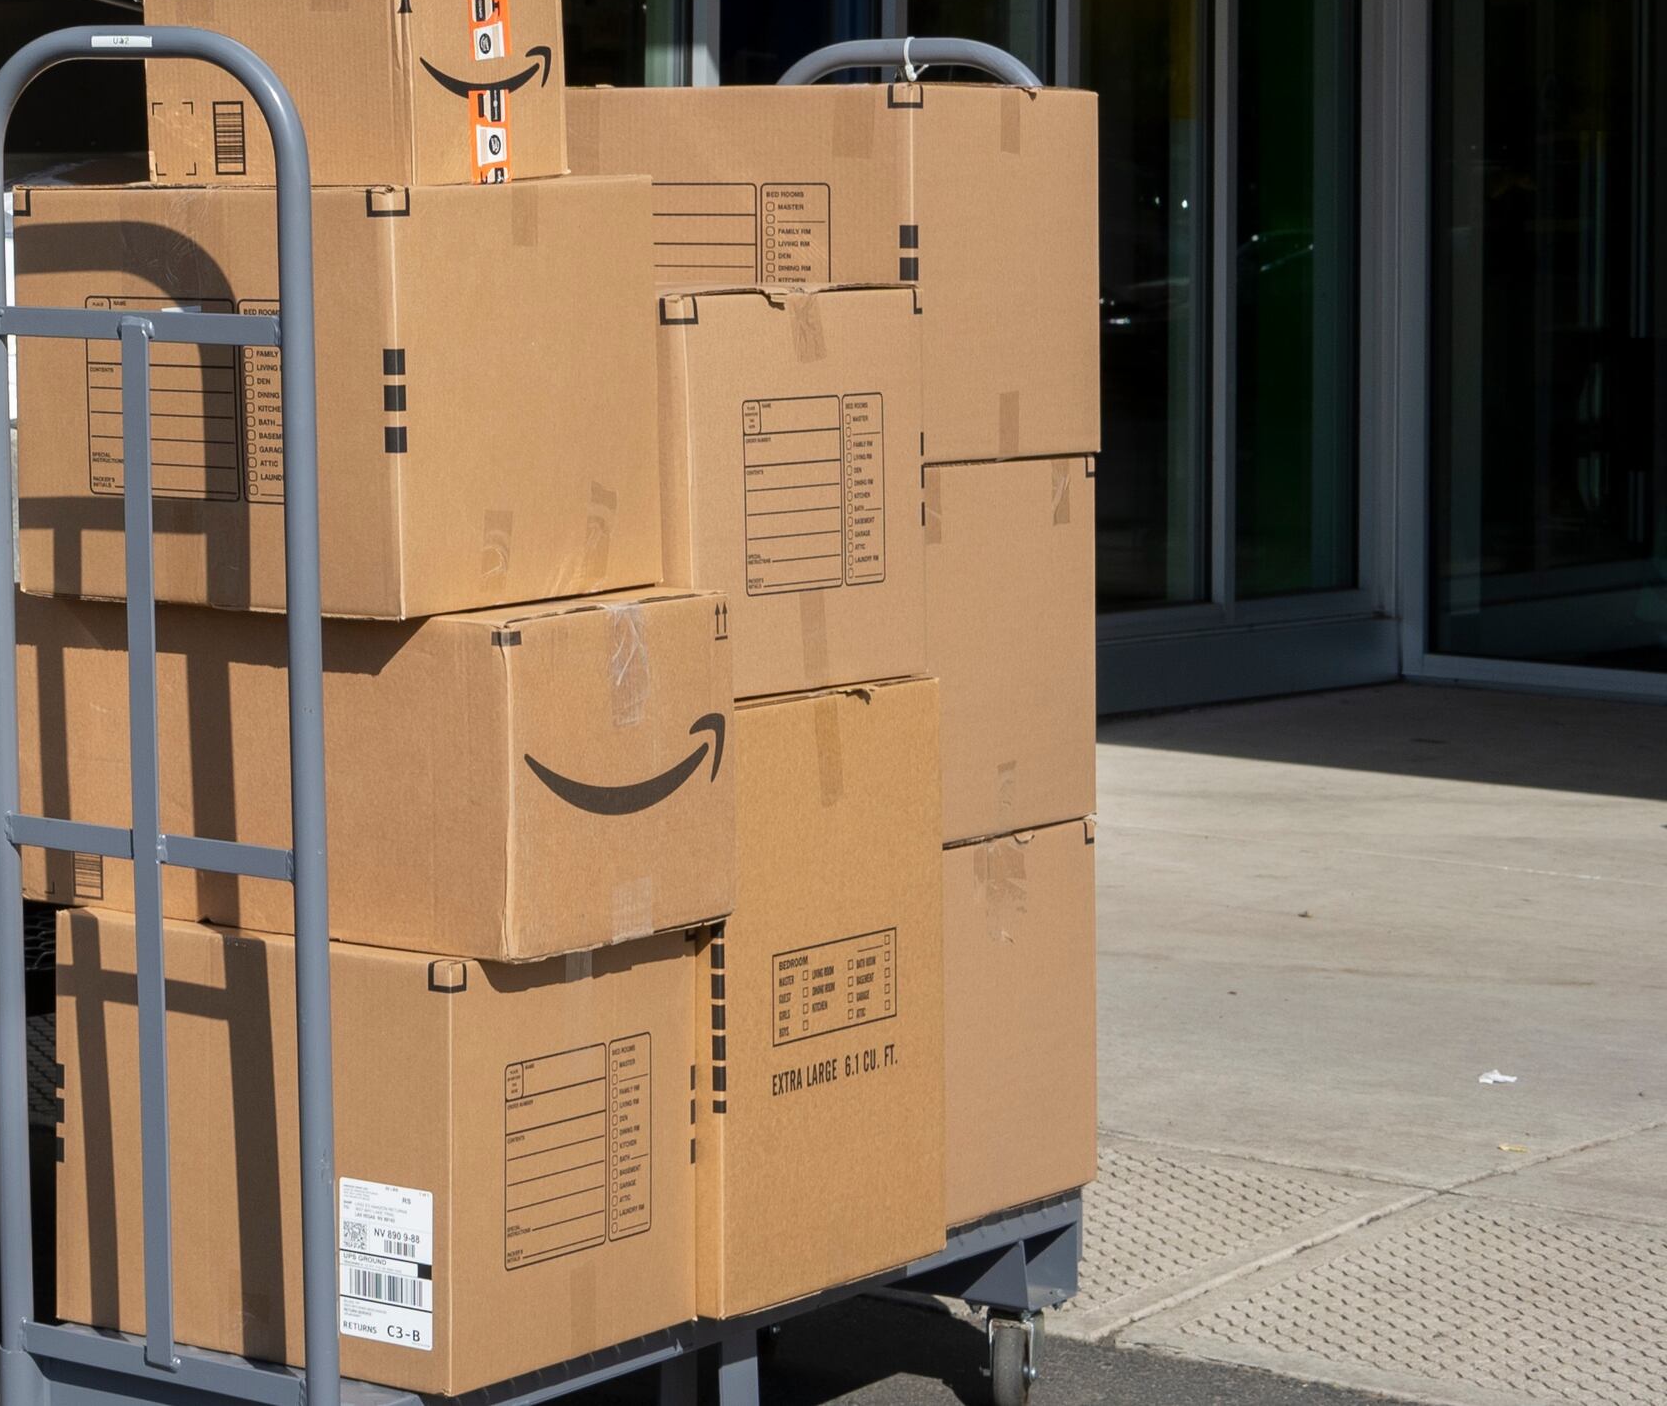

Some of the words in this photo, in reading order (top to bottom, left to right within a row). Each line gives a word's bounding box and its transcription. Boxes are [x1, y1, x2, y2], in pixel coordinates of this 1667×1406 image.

[778, 956, 808, 971] BEDROOM
[772, 1067, 803, 1096] EXTRA
[807, 1058, 837, 1087] LARGE
[845, 1053, 859, 1077] 6.1
[863, 1048, 879, 1072] CU.
[884, 1044, 898, 1067] FT.
[374, 1228, 385, 1237] NV
[387, 1230, 401, 1240] 890
[403, 1233, 420, 1244] 9-88
[343, 1253, 357, 1261] UPS
[358, 1255, 387, 1266] GROUND
[343, 1320, 377, 1334] RETURNS
[387, 1325, 420, 1342] C3-B
